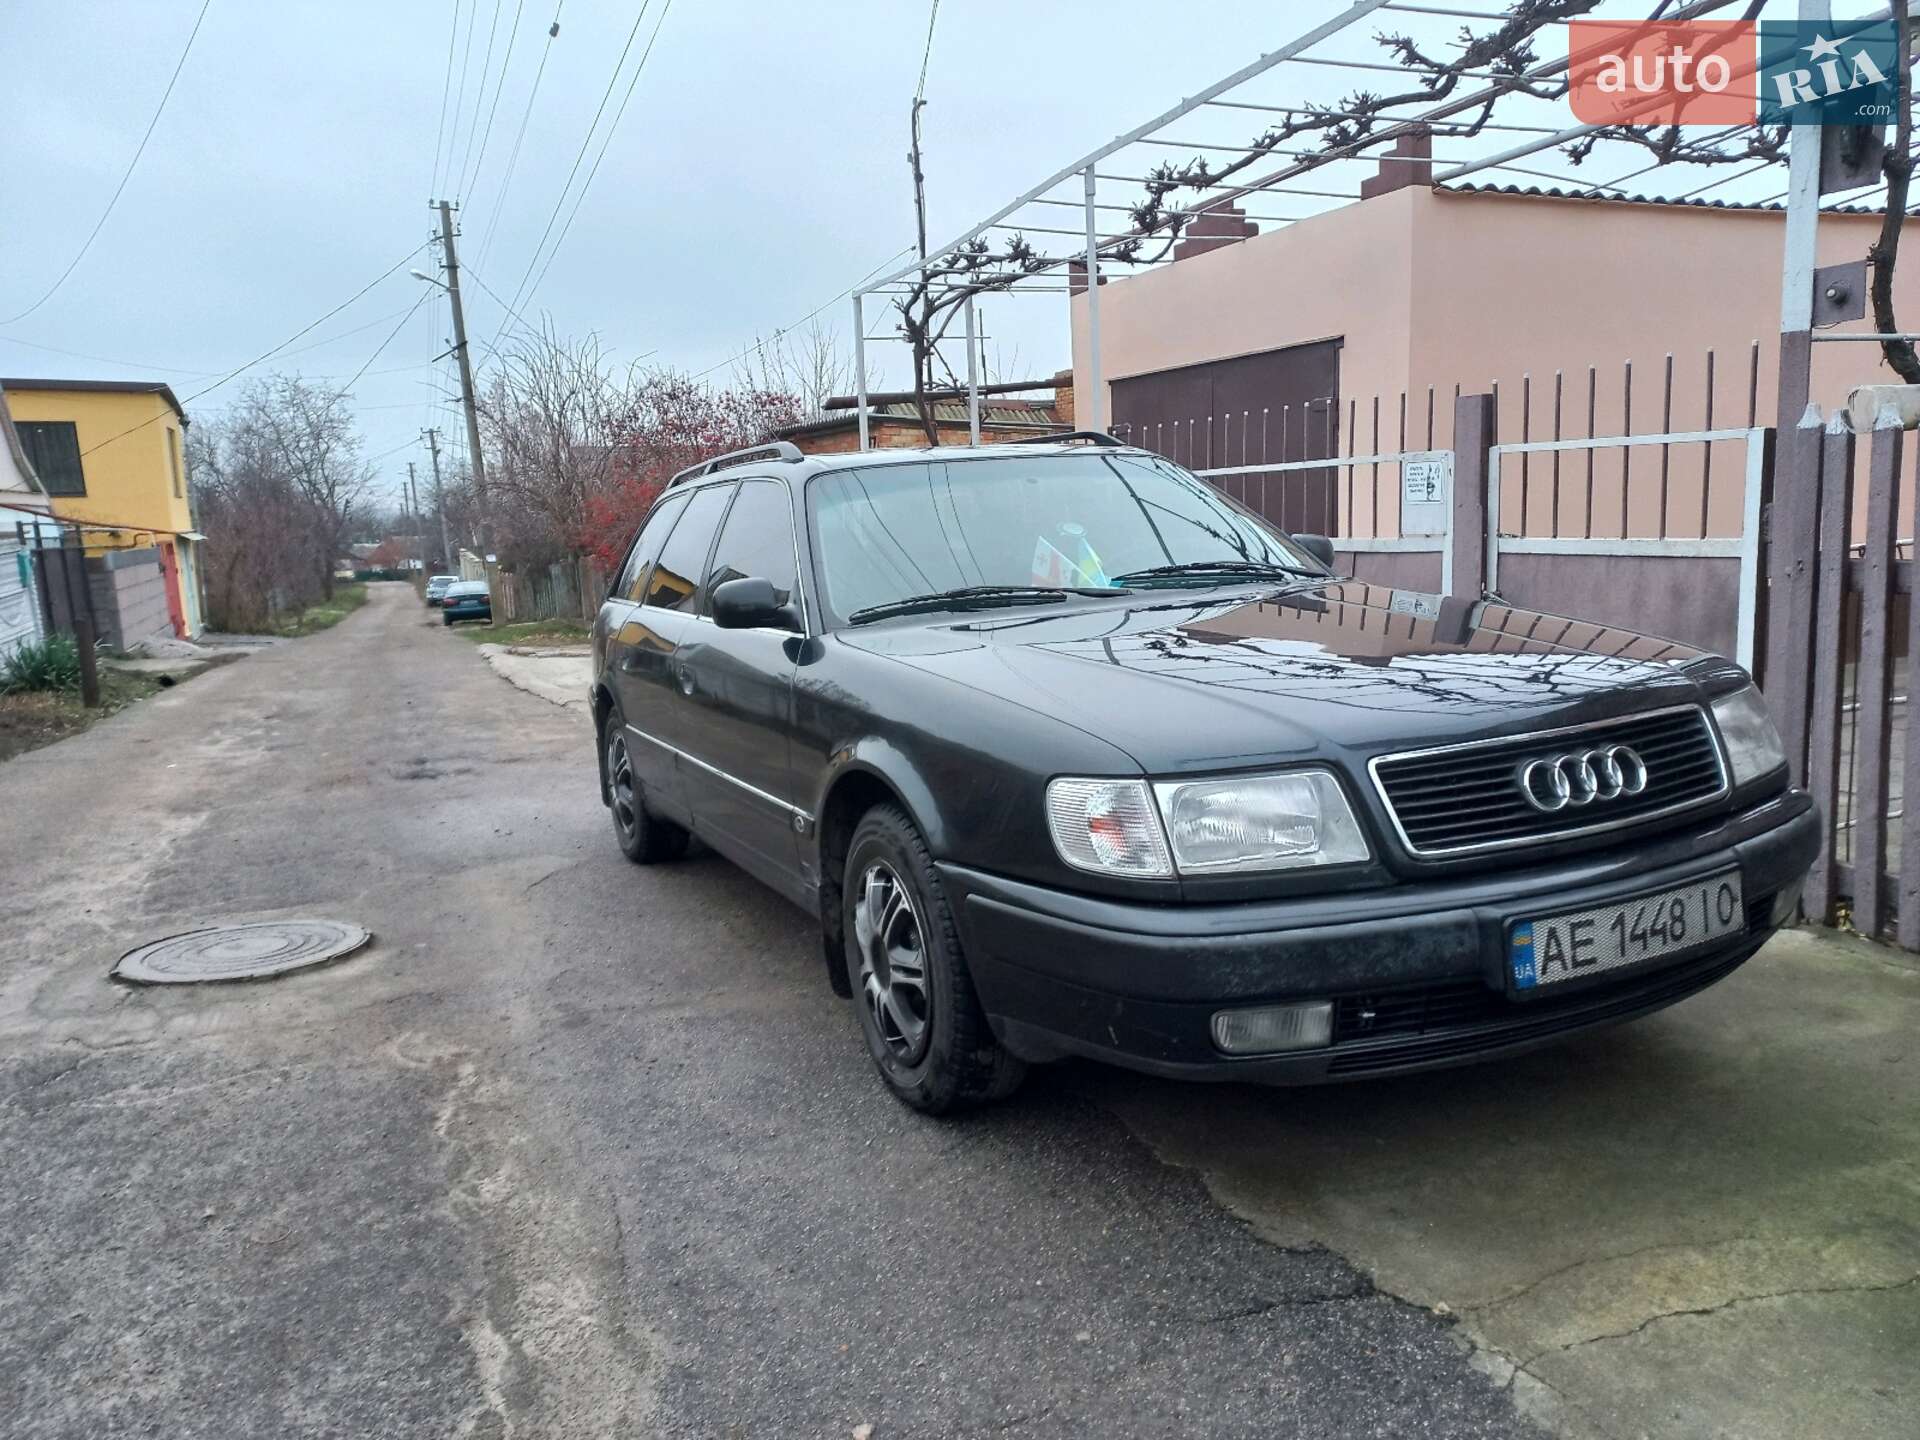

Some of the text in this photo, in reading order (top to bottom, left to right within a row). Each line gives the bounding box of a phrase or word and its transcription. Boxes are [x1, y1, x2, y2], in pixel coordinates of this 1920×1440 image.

[1540, 919, 1598, 975] AE
[1610, 898, 1686, 958] 1448
[1514, 964, 1534, 980] UA
